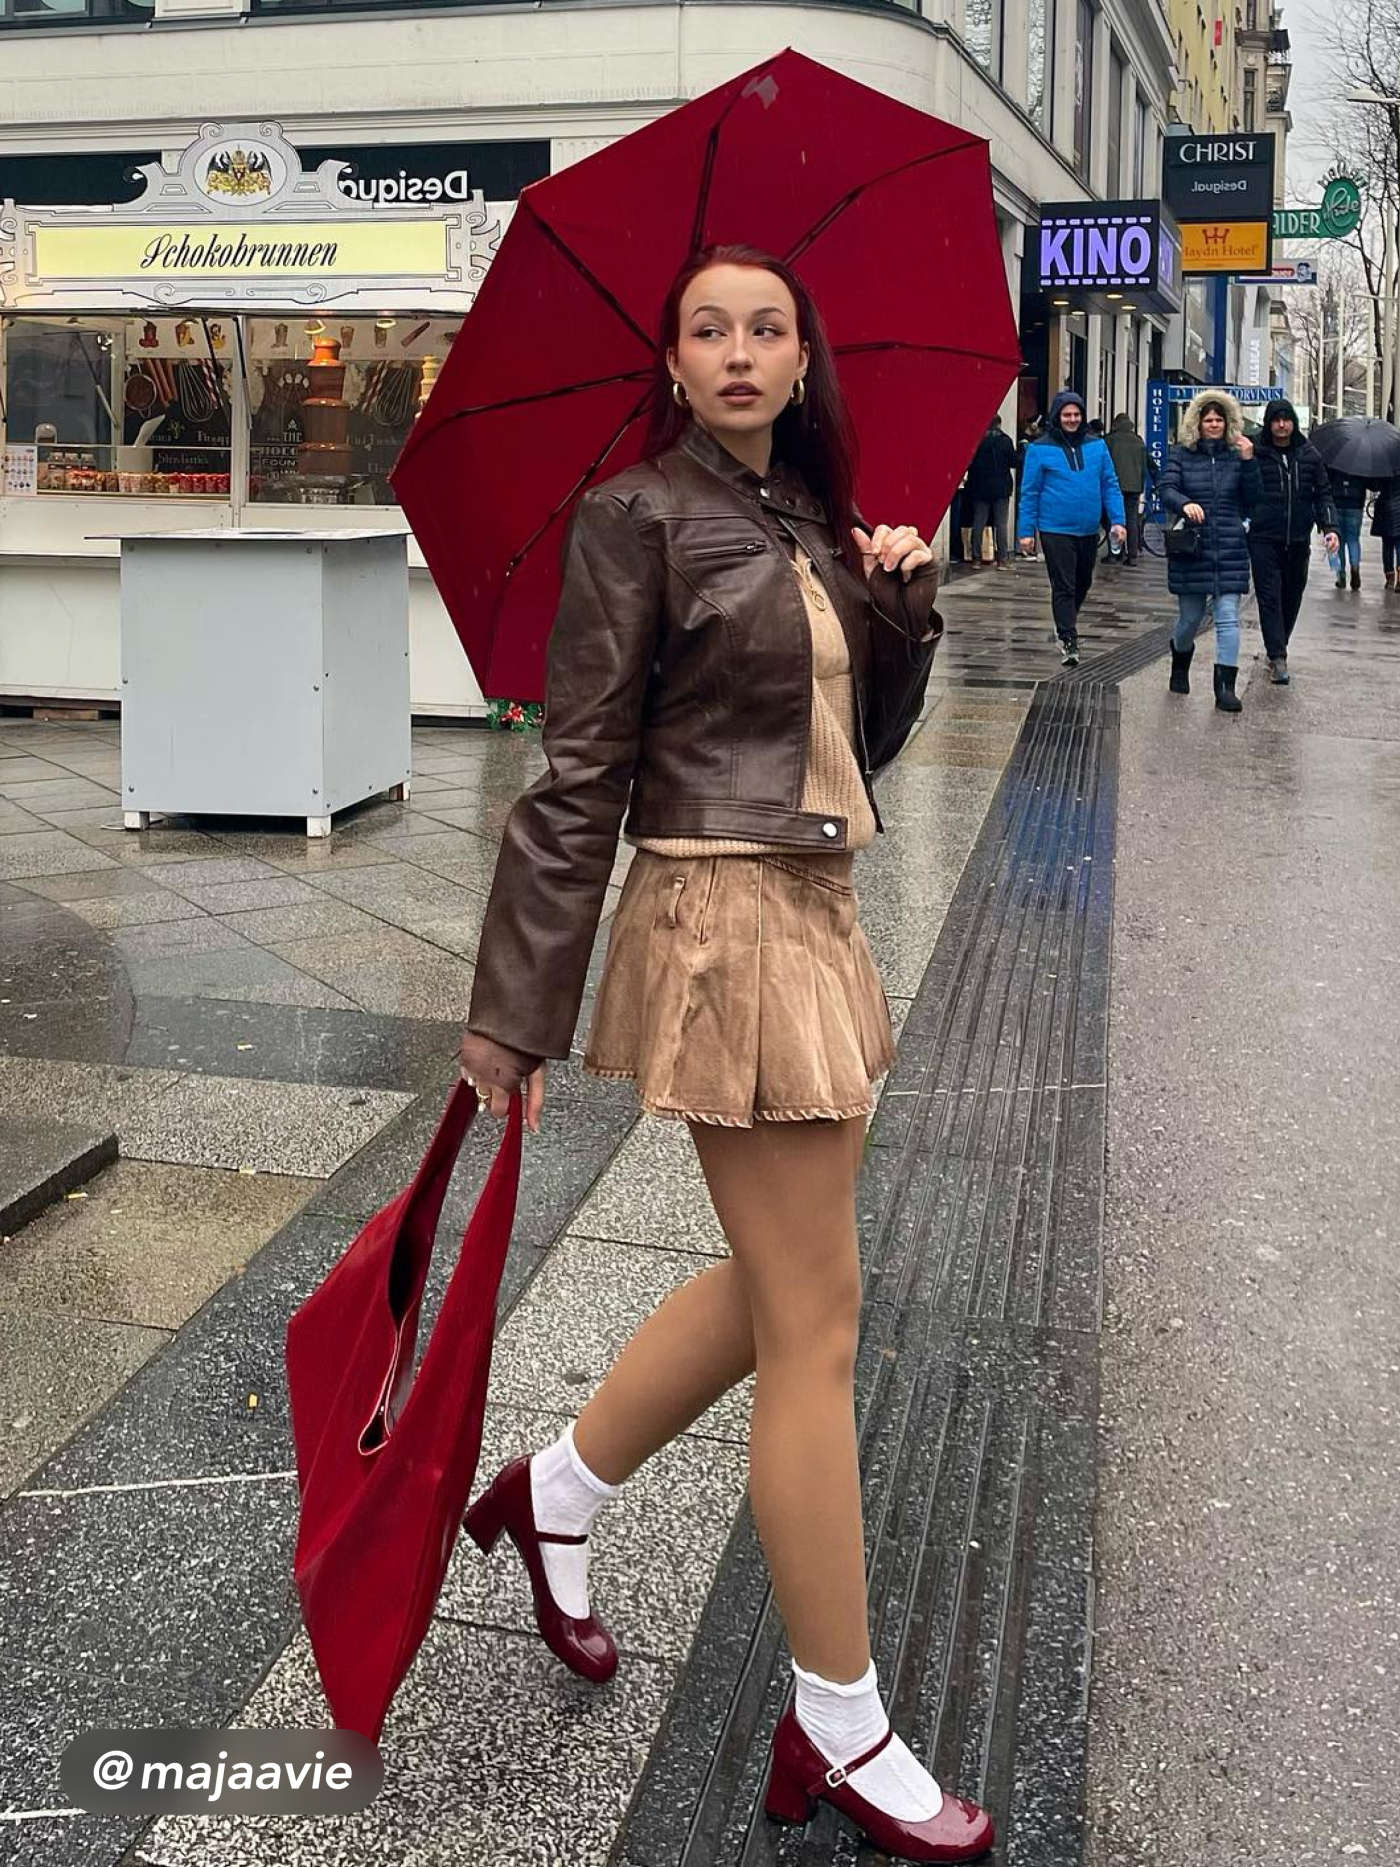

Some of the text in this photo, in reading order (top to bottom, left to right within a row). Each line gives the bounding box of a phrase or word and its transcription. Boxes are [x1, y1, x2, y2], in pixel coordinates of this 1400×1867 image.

[1179, 141, 1257, 163] CHRIST
[140, 232, 338, 269] Schokobrunnen
[1040, 225, 1151, 276] KINO
[1152, 388, 1163, 432] HOTEL
